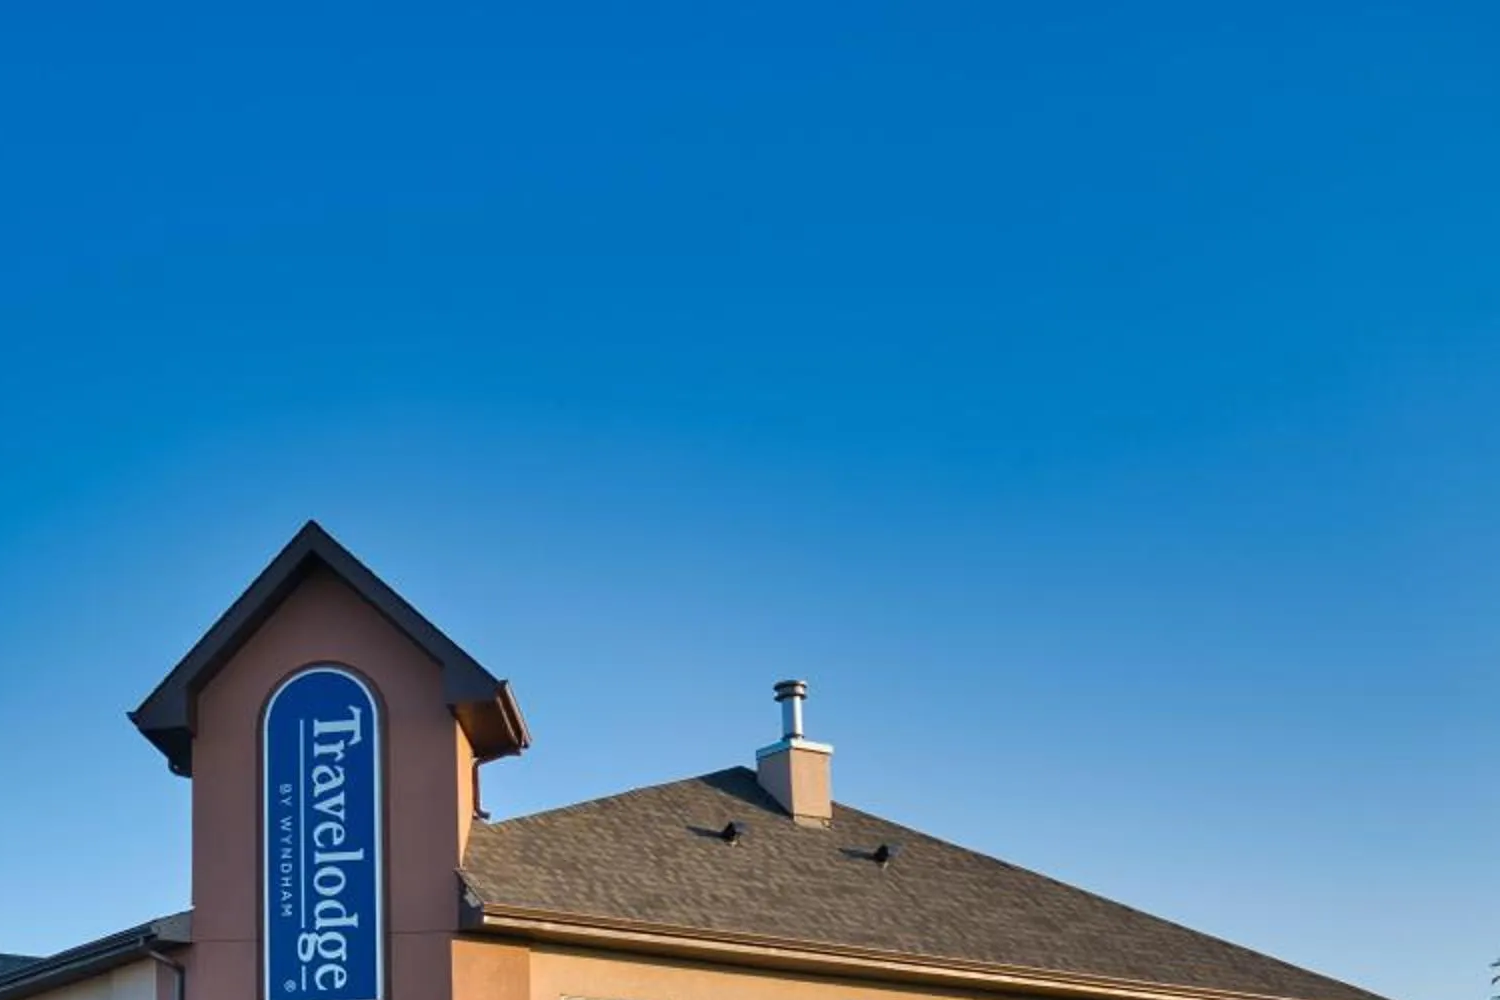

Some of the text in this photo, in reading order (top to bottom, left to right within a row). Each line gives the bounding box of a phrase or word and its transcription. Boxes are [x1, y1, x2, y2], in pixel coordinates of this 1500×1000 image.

[279, 783, 294, 918] BY WYNDHAM
[297, 705, 365, 992] Travelodge
